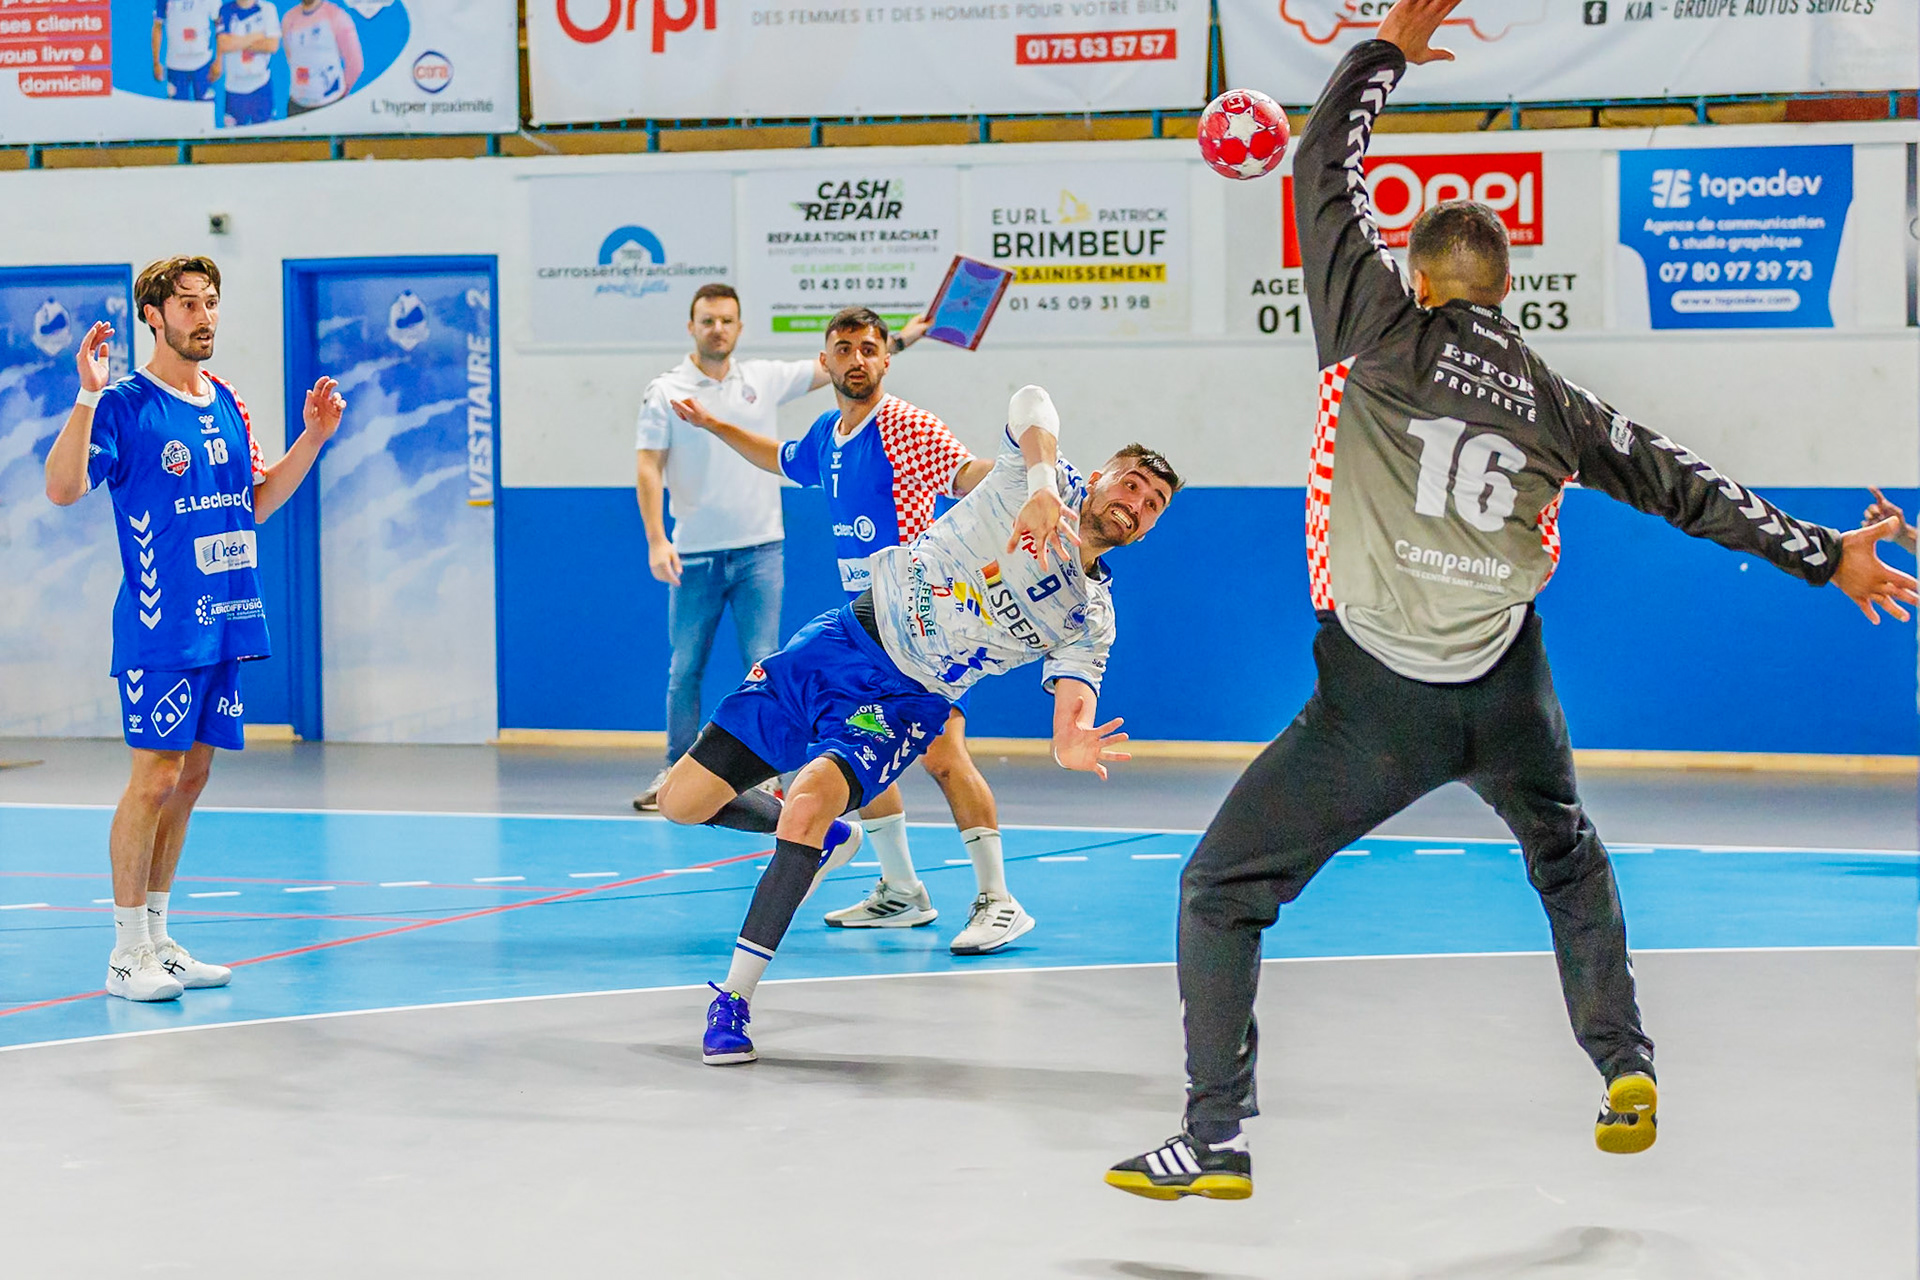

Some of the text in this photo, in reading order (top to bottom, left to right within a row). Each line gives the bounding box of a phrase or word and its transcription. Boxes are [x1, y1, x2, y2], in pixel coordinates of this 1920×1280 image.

[752, 10, 784, 26] DES
[789, 8, 860, 25] FEMMES
[866, 7, 884, 23] ET
[891, 6, 926, 23] DES
[931, 4, 1010, 21] HOMMES
[1624, 0, 1652, 21] KIA
[35, 14, 103, 33] clients
[41, 45, 85, 62] livre
[1079, 36, 1109, 59] 63
[1111, 35, 1138, 58] 57
[1140, 34, 1168, 57] 57
[20, 74, 104, 93] domicile
[817, 179, 890, 201] CASH
[1699, 167, 1823, 206] topadev
[804, 201, 903, 222] REPAIR
[991, 207, 1168, 226] EURL PATRICK
[860, 230, 876, 243] ET
[879, 228, 938, 243] RACHAT
[1643, 218, 1696, 236] Agence
[1717, 215, 1826, 231] communication
[992, 229, 1167, 259] BRIMBEUF
[1681, 235, 1727, 250] studio
[1728, 233, 1803, 253] graphique
[1013, 264, 1165, 281] SAINISSEMENT
[1658, 259, 1814, 283] 07 80 97 39 73
[1251, 278, 1307, 296] AGE
[1009, 295, 1151, 311] 01 45 09 31 98
[1258, 304, 1302, 334] 01
[1520, 301, 1569, 331] 63
[465, 288, 493, 497] VESTAIRE 2
[1433, 370, 1537, 424] PROPRETÉ
[204, 437, 229, 466] 18
[1406, 416, 1528, 532] 16
[1394, 539, 1513, 580] Campanile
[1026, 573, 1062, 603] 9
[955, 602, 965, 613] TP
